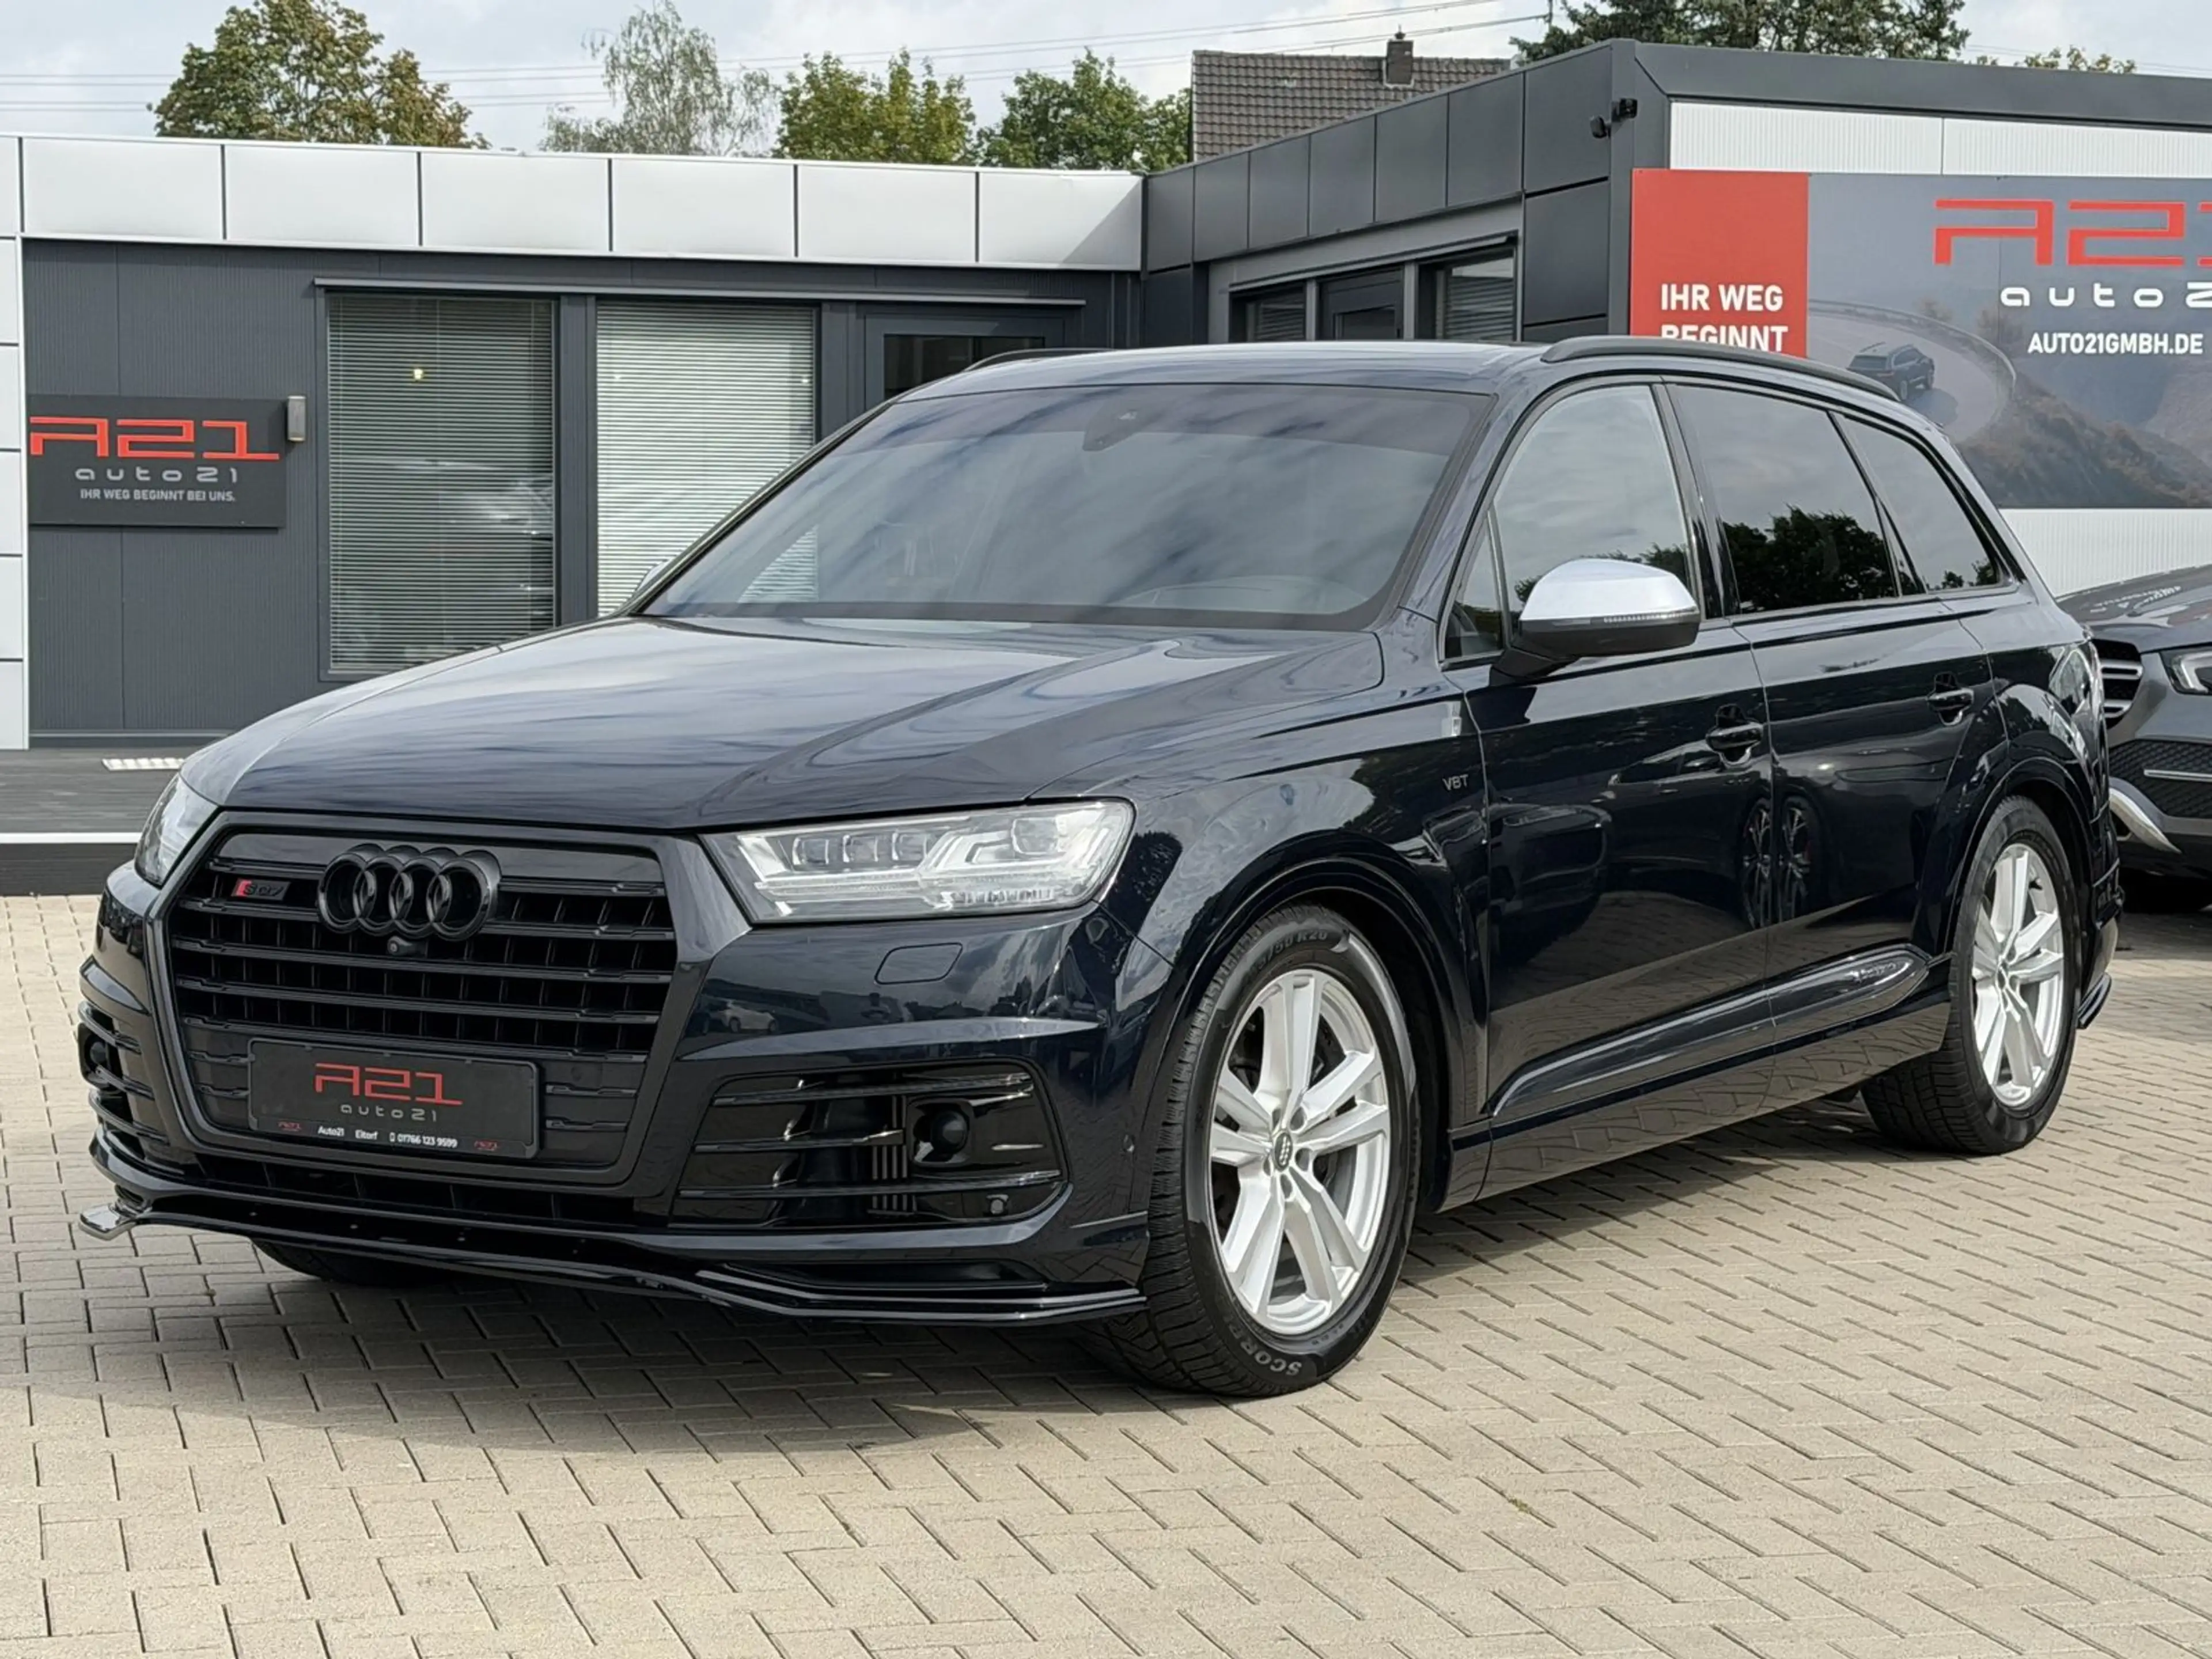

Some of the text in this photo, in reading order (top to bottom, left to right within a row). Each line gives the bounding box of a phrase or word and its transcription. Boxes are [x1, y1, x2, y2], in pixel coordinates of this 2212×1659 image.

[1933, 199, 2212, 266] A2
[1661, 284, 1783, 312] IHR WEG
[2028, 332, 2203, 354] AUTO21GMBH.DE
[30, 416, 279, 460] A21
[80, 488, 236, 503] IHR WEG BEGINNT BEI UNS.
[315, 1062, 463, 1105] A21
[318, 1126, 344, 1137] Auto21
[355, 1129, 378, 1140] Eitorf
